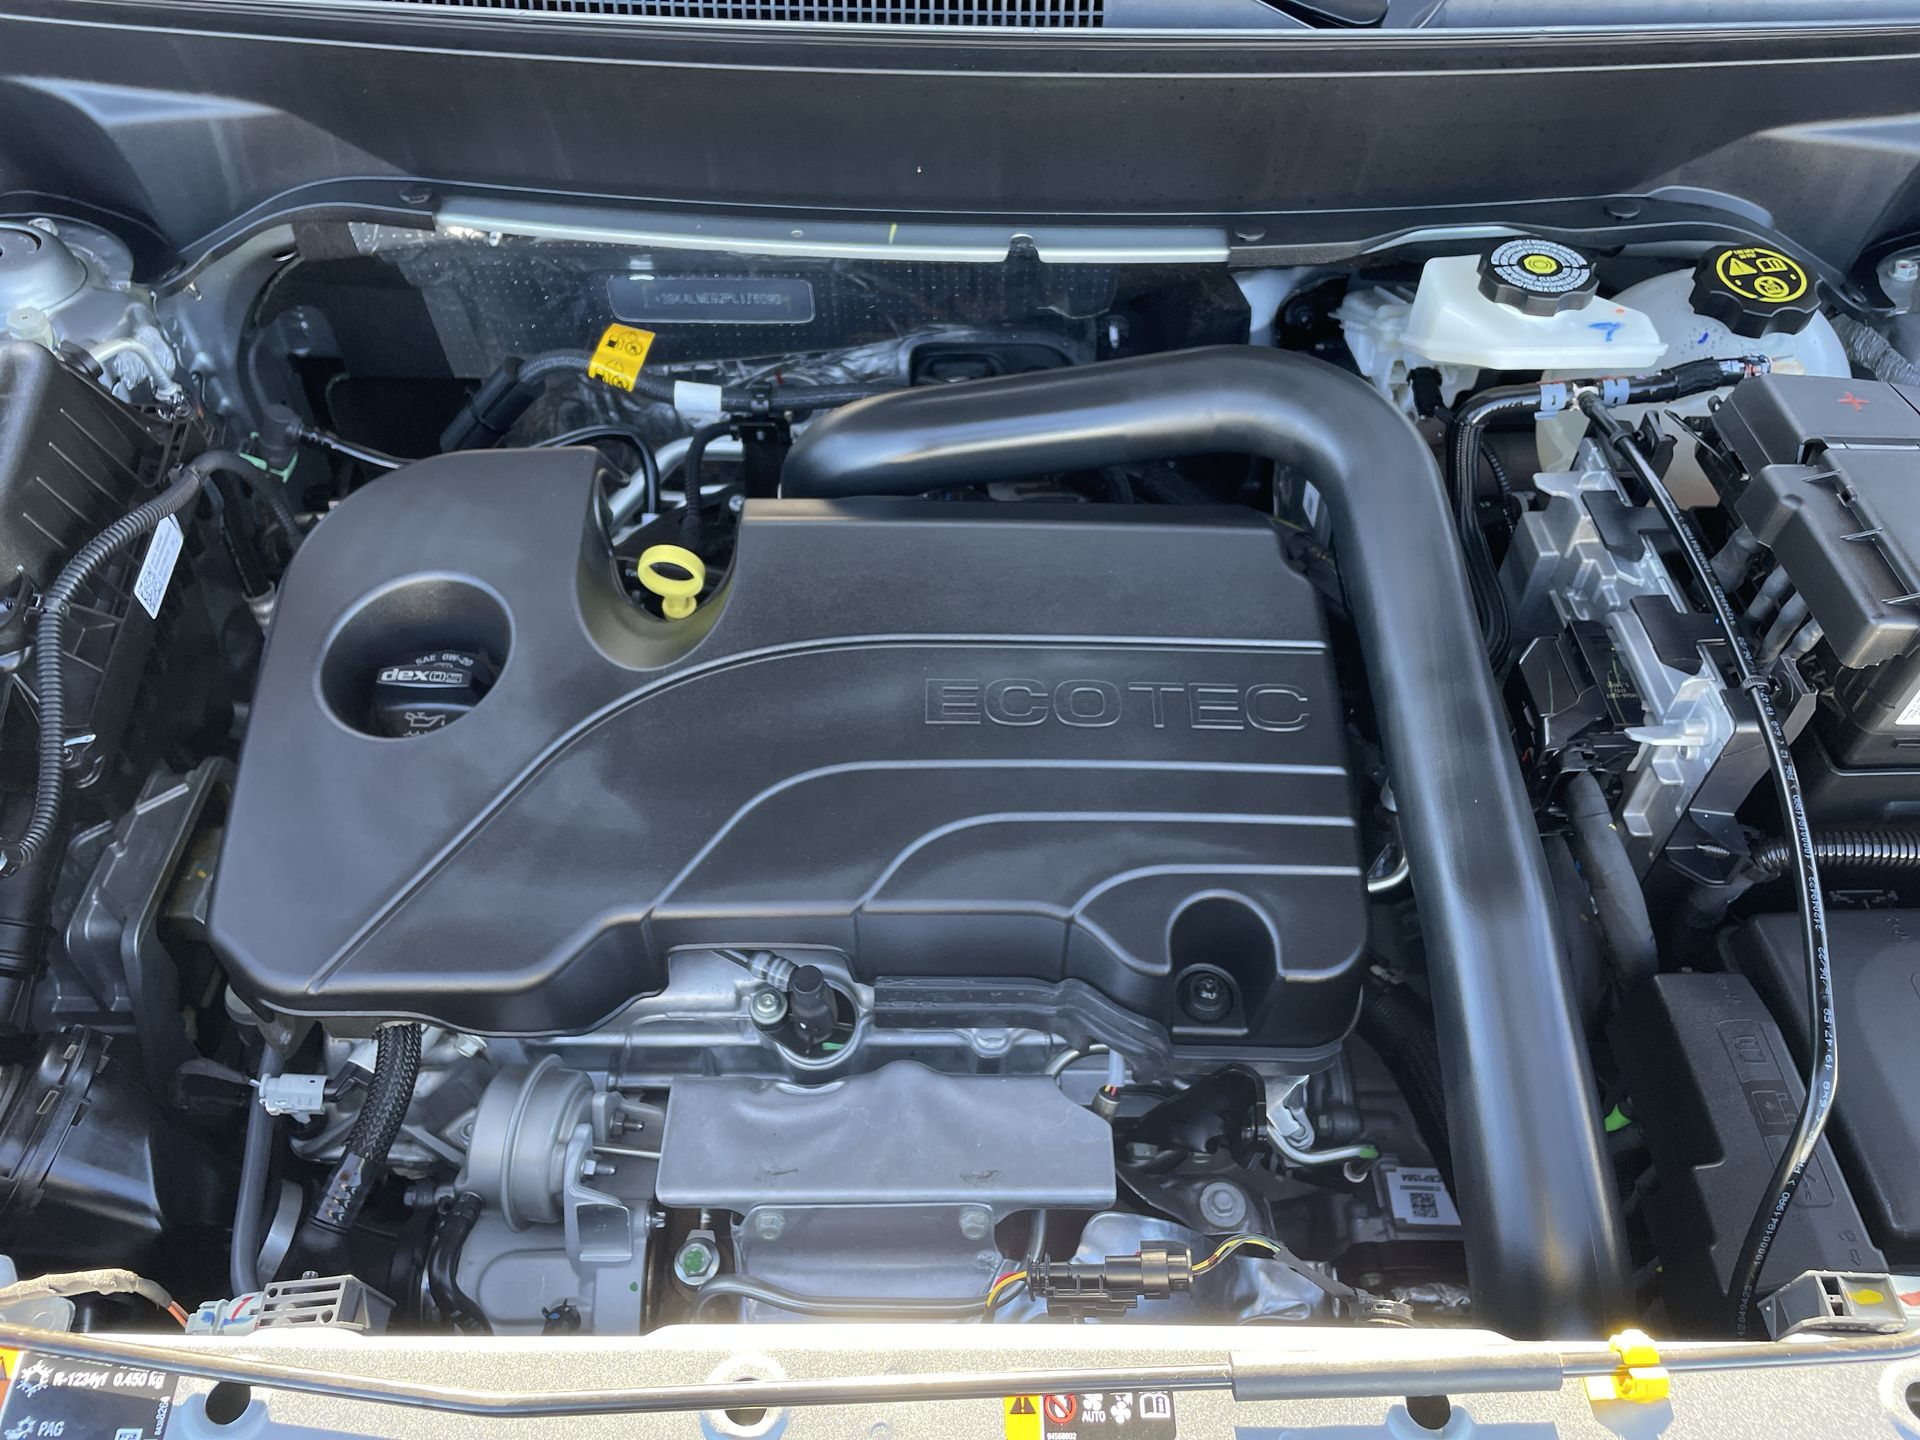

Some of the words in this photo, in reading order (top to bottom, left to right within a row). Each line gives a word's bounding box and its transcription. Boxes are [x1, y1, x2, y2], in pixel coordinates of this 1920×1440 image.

[415, 654, 436, 666] SAE
[925, 678, 1310, 732] ECOTEC
[1736, 1285, 1753, 1339] 12049423
[112, 1372, 147, 1388] 0.450
[1081, 1410, 1106, 1422] AUTO
[37, 1420, 65, 1437] PAG
